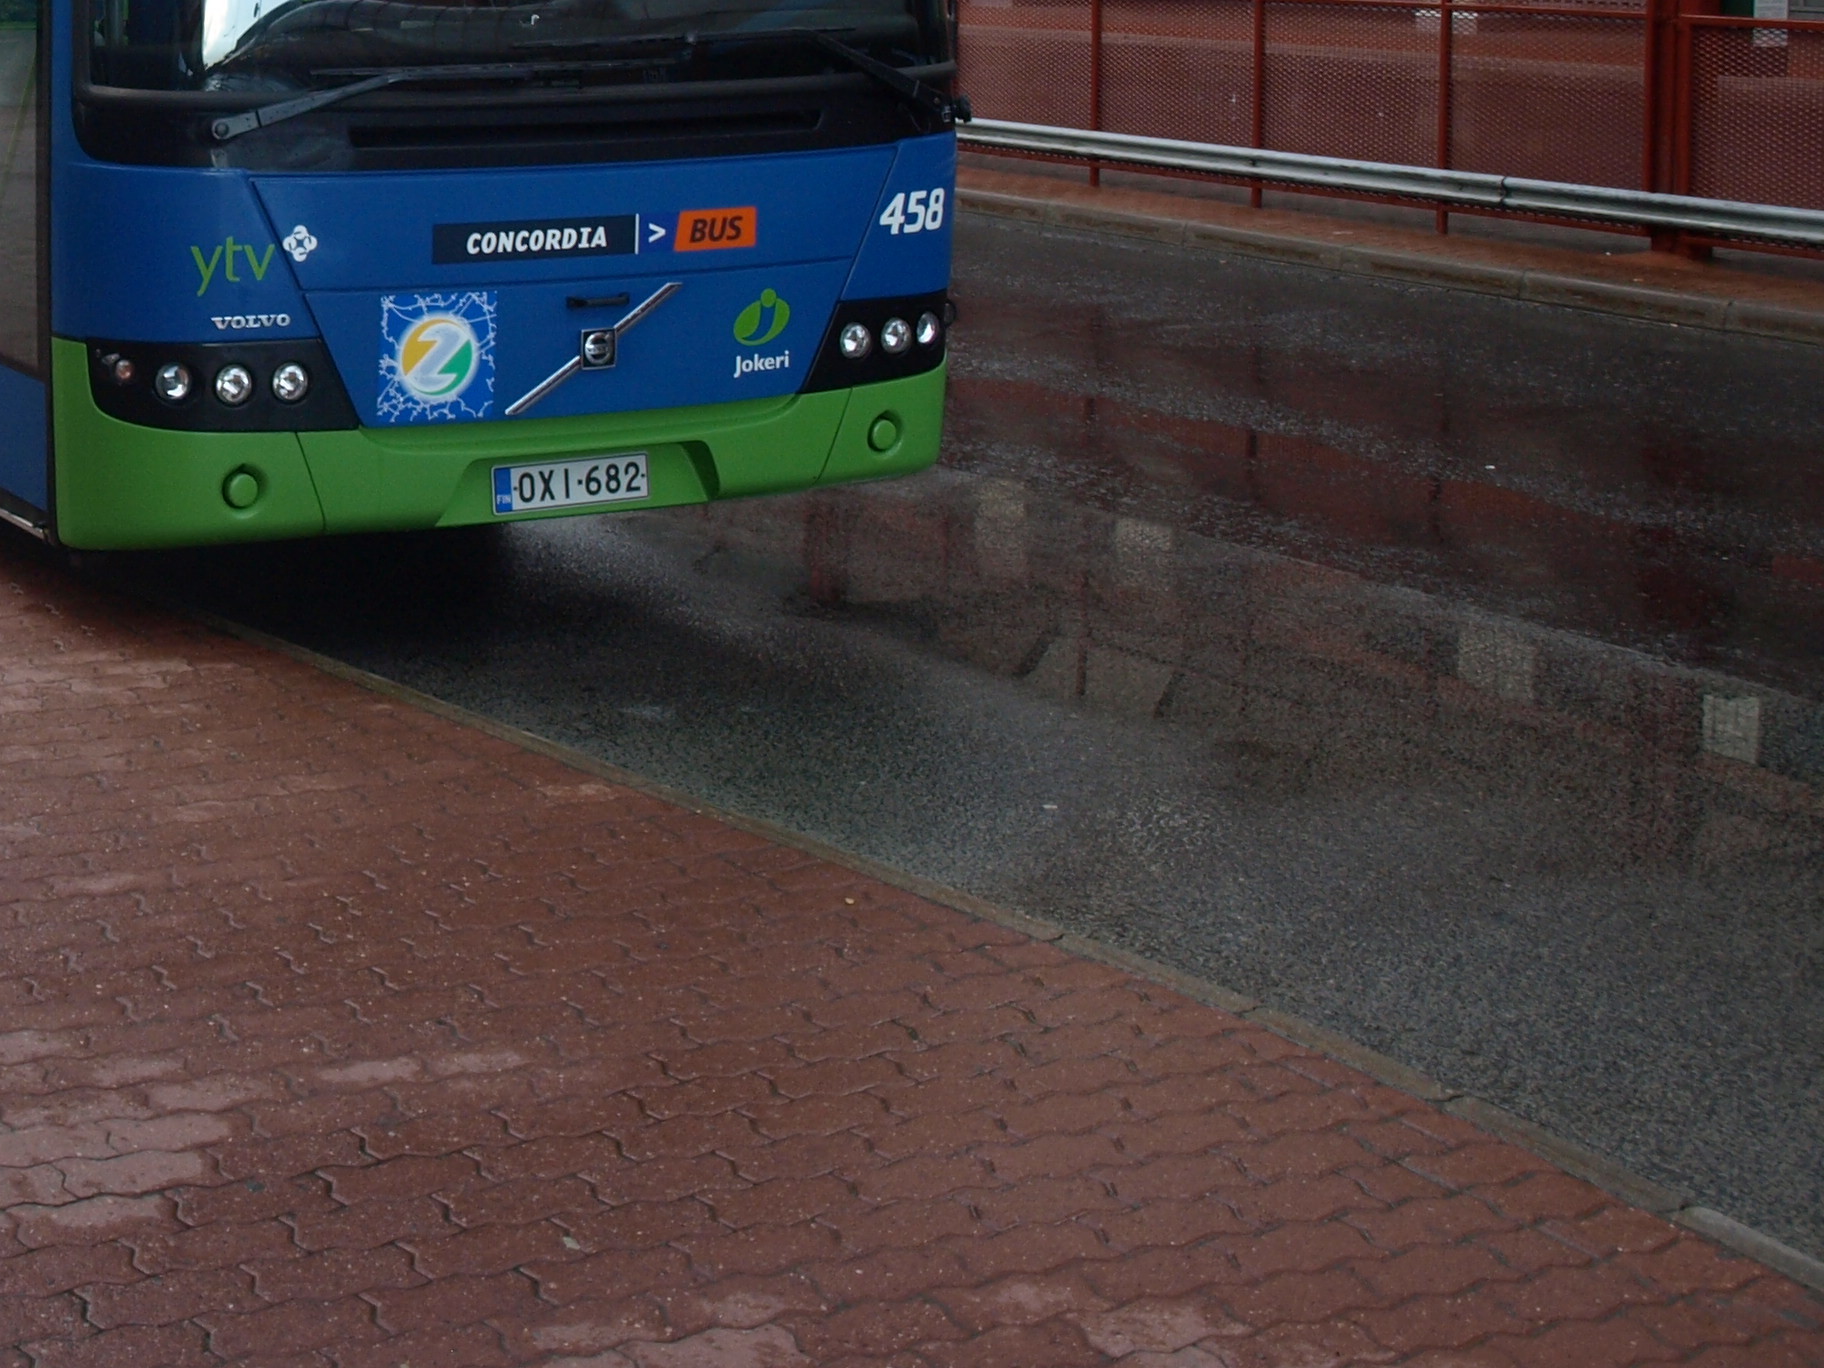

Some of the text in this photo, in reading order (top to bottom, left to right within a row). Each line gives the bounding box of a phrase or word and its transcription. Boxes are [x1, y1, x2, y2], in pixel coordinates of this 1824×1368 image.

[880, 188, 946, 236] 458
[466, 215, 744, 255] CONCORDIA BUS
[191, 236, 276, 297] ytv
[211, 313, 291, 330] VOLVO
[733, 351, 791, 378] Jokeri
